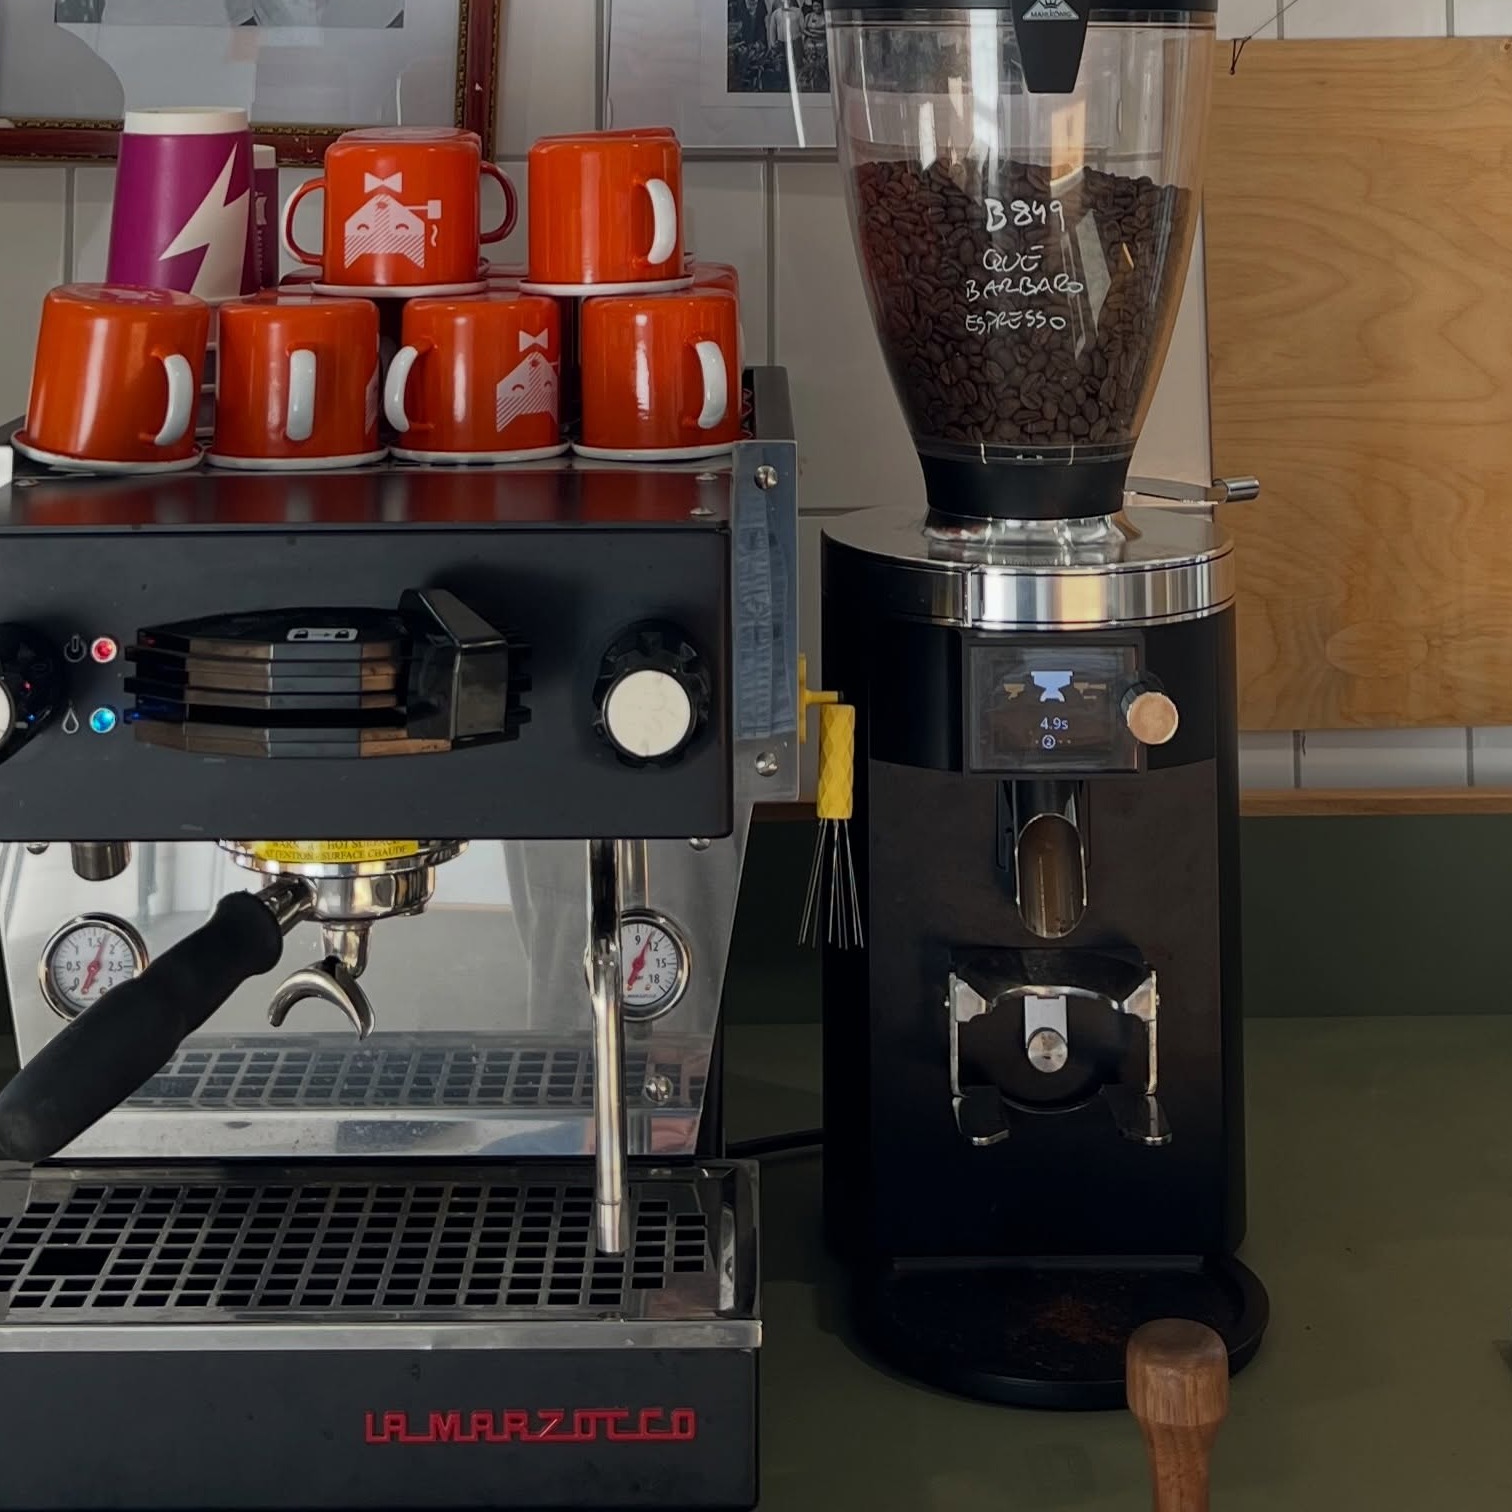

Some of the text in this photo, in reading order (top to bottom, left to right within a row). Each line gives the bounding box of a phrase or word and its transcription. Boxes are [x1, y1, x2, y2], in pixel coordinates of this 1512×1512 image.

[635, 935, 641, 945] 9
[655, 958, 666, 968] 15
[649, 974, 660, 984] 18
